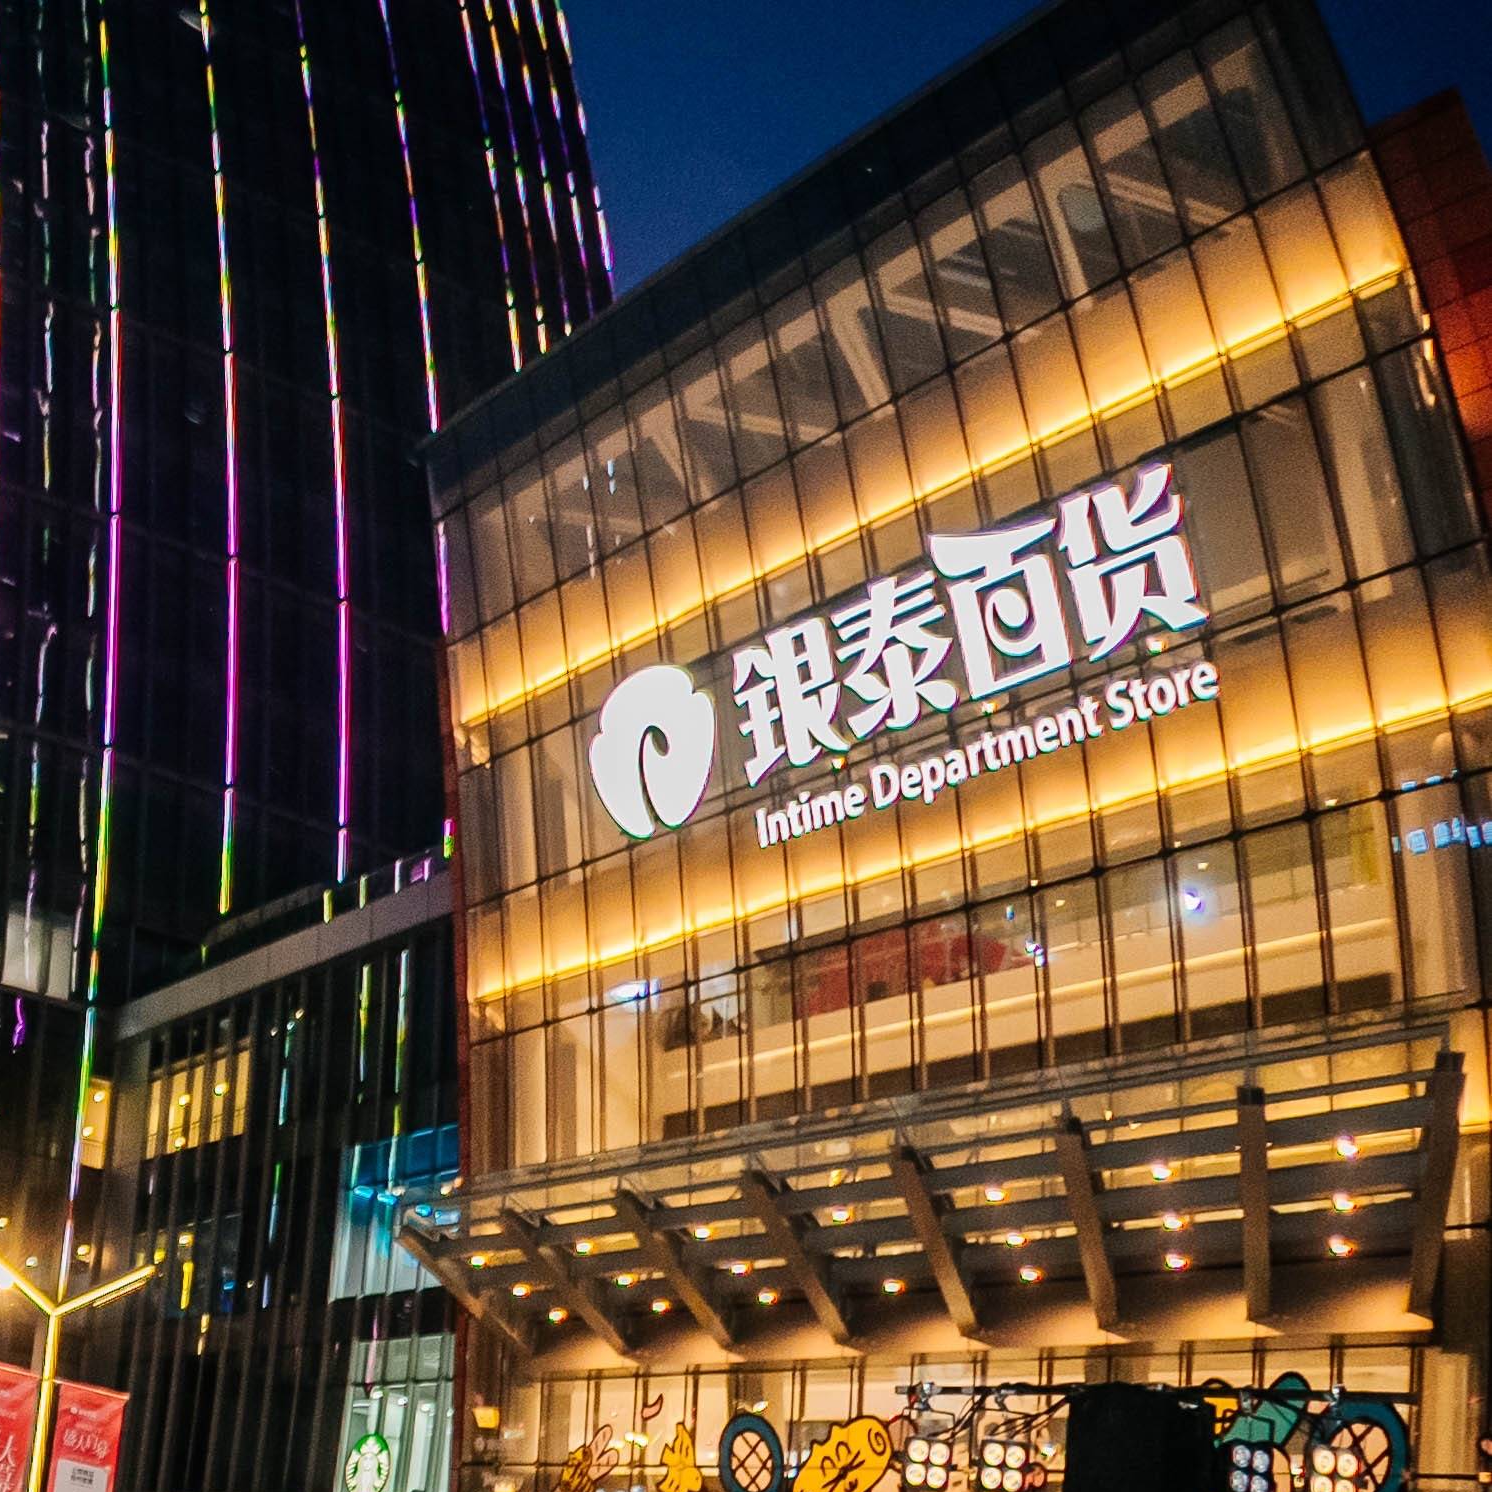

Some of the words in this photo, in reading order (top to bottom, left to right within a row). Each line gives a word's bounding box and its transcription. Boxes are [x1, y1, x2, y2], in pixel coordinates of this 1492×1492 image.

[732, 461, 1211, 788] 银泰百货
[754, 781, 865, 850] Intime
[869, 695, 1105, 814] Department
[1105, 658, 1221, 730] Store
